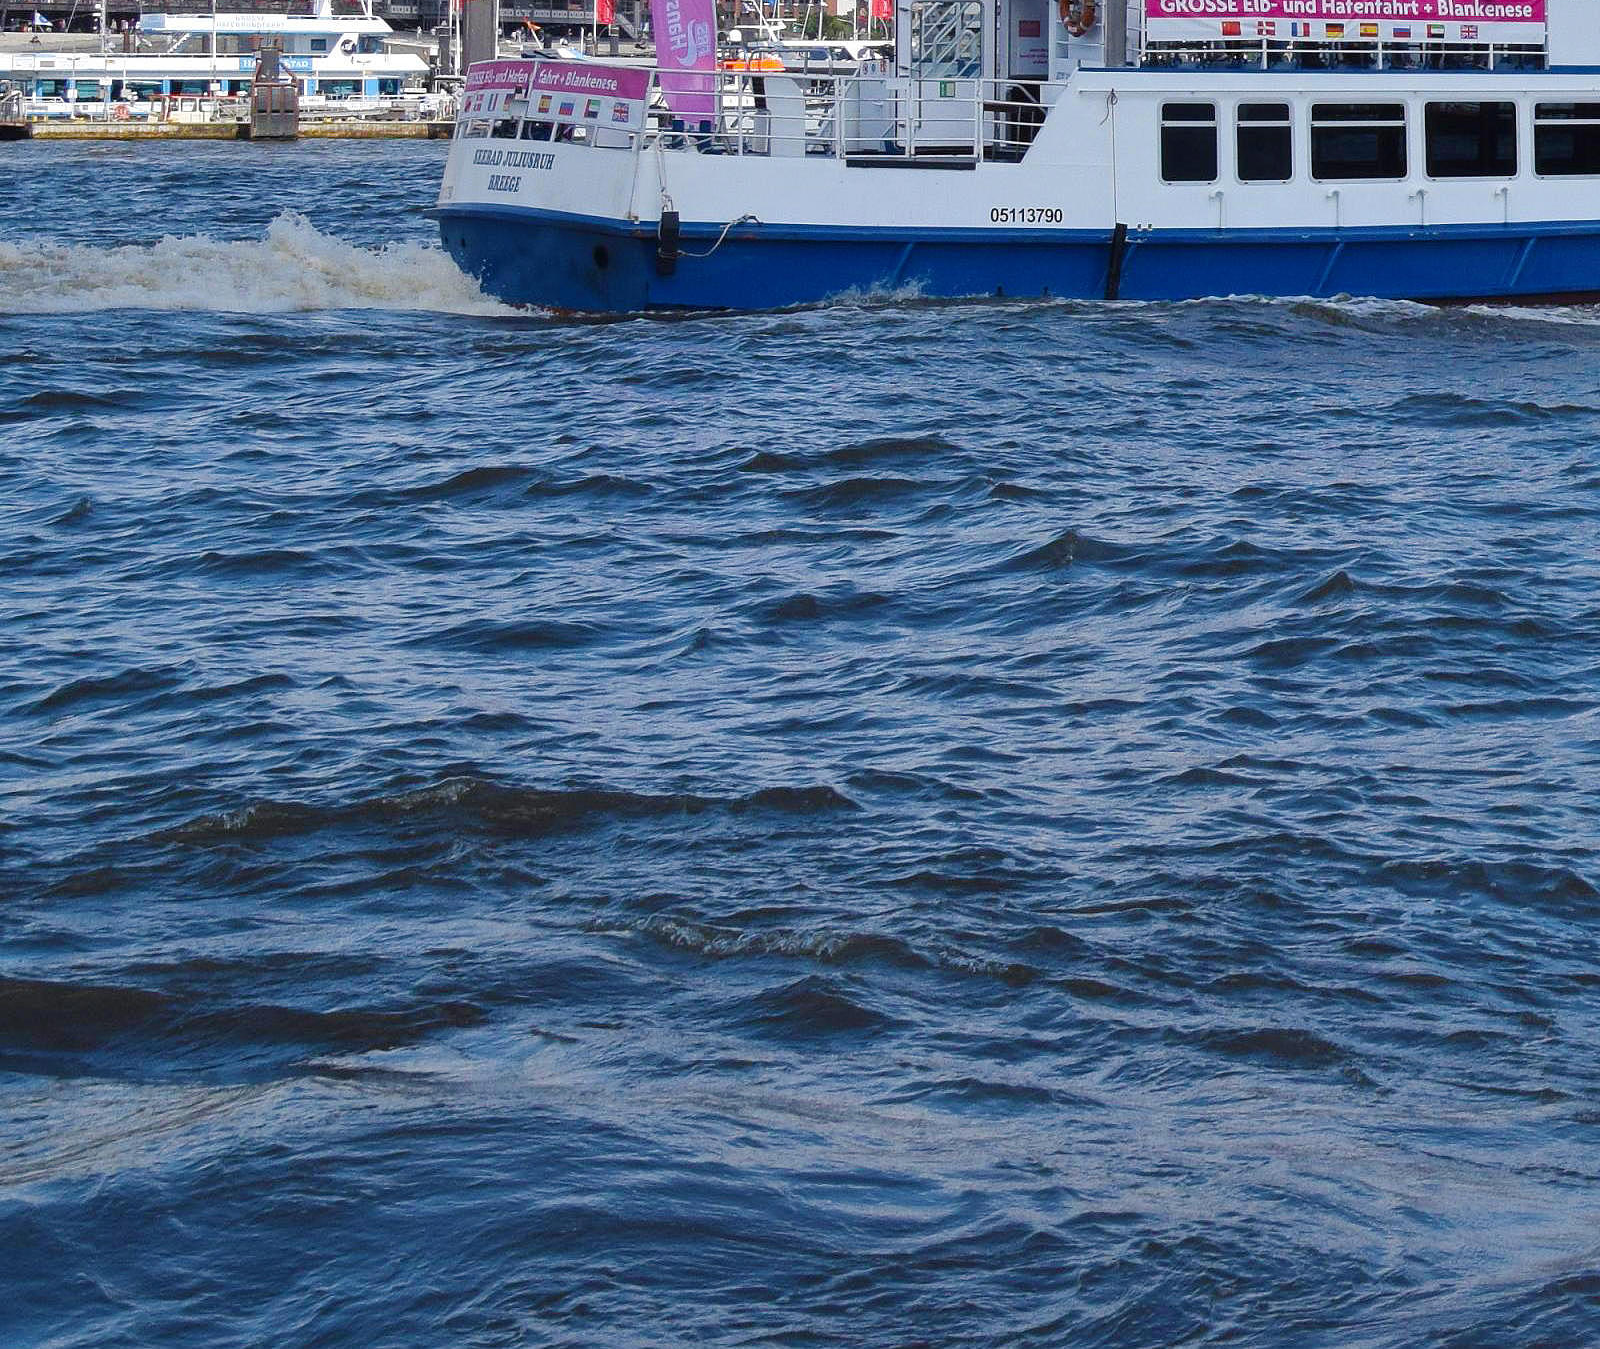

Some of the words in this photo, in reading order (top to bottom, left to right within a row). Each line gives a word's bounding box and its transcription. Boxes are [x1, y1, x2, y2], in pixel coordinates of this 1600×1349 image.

[1424, 2, 1433, 13] +
[565, 70, 618, 90] Blankenese
[503, 150, 555, 170] JULIUSRUH
[990, 207, 1063, 223] 05113790
